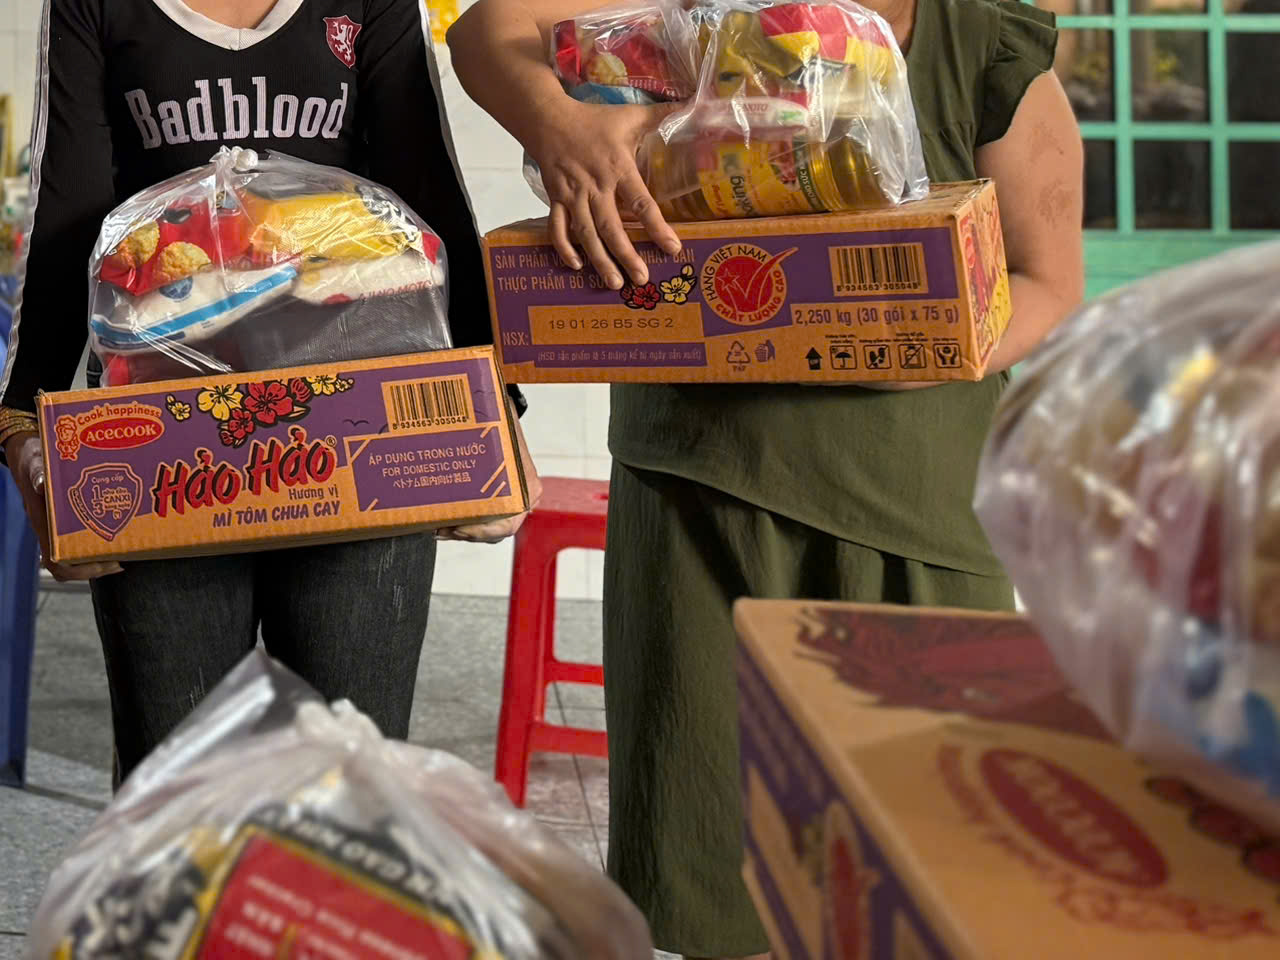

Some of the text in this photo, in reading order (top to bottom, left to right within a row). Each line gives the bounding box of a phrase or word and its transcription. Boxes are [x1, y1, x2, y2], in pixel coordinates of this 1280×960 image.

[497, 276, 528, 294] THỰC
[531, 269, 565, 290] PHẨM
[570, 272, 585, 289] BỔ
[703, 245, 767, 301] HÀNG VIỆT NAM
[549, 318, 674, 330] 19 01 26 B5 SG 2
[795, 306, 959, 327] 2,250 kg (30 gói x 75 g)
[503, 332, 529, 346] NSX:
[77, 404, 160, 426] Cook happiness
[368, 442, 487, 466] ÁP DỤNG TRONG NƯỚC
[152, 449, 242, 518] Hảo
[246, 427, 336, 496] Hảo
[382, 459, 477, 478] FOR DOMESTIC ONLY
[288, 484, 339, 501] Hương vị
[212, 500, 341, 528] MÌ TÔM CHUA CAY
